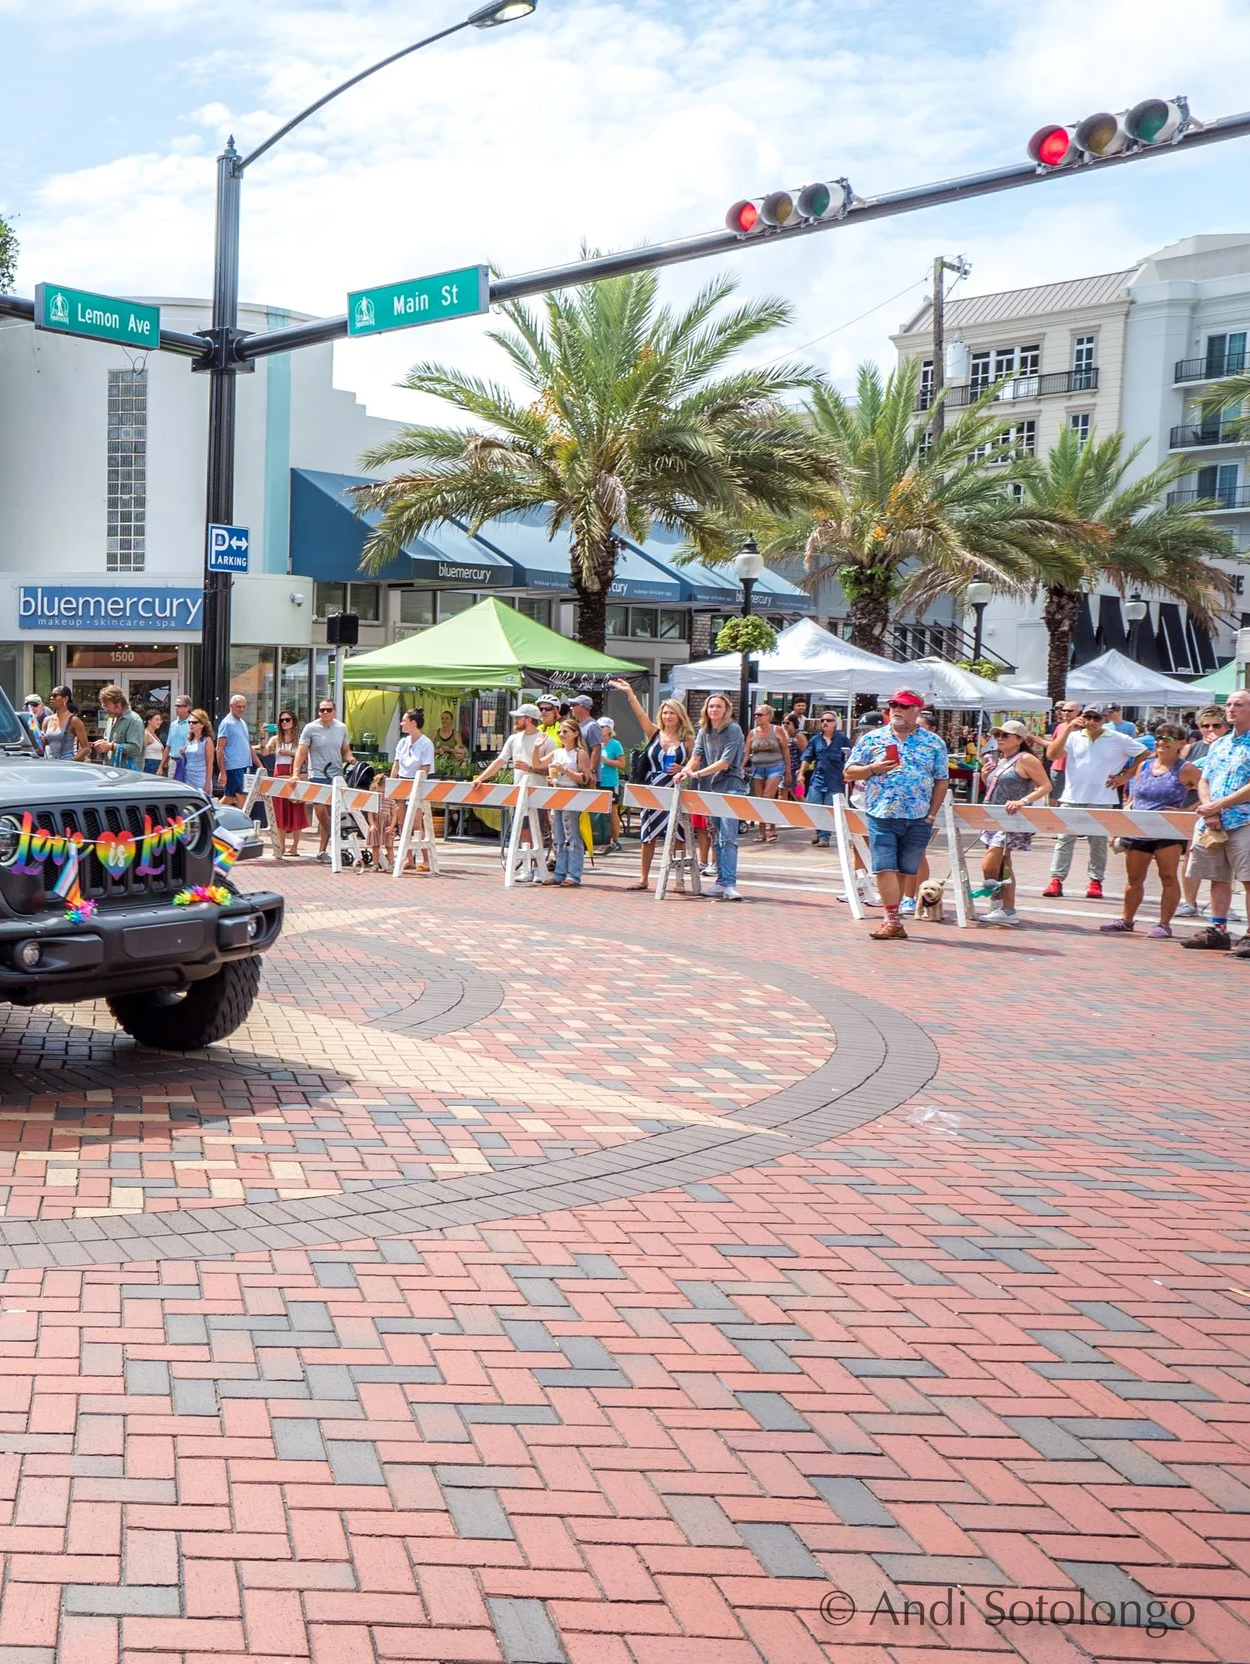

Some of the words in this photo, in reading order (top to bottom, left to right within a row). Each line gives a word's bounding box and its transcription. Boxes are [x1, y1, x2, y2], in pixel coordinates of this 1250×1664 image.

[393, 292, 429, 316] Main
[441, 284, 459, 306] St
[78, 303, 119, 328] Lemon
[128, 313, 150, 335] Ave
[438, 562, 492, 583] bluemercury
[19, 587, 203, 625] bluemercury
[736, 590, 773, 607] blumercury
[38, 618, 83, 628] makeup
[94, 618, 145, 627] skincare
[156, 620, 175, 628] spa
[110, 651, 134, 662] 1500
[10, 811, 94, 875] Love
[108, 843, 127, 867] is
